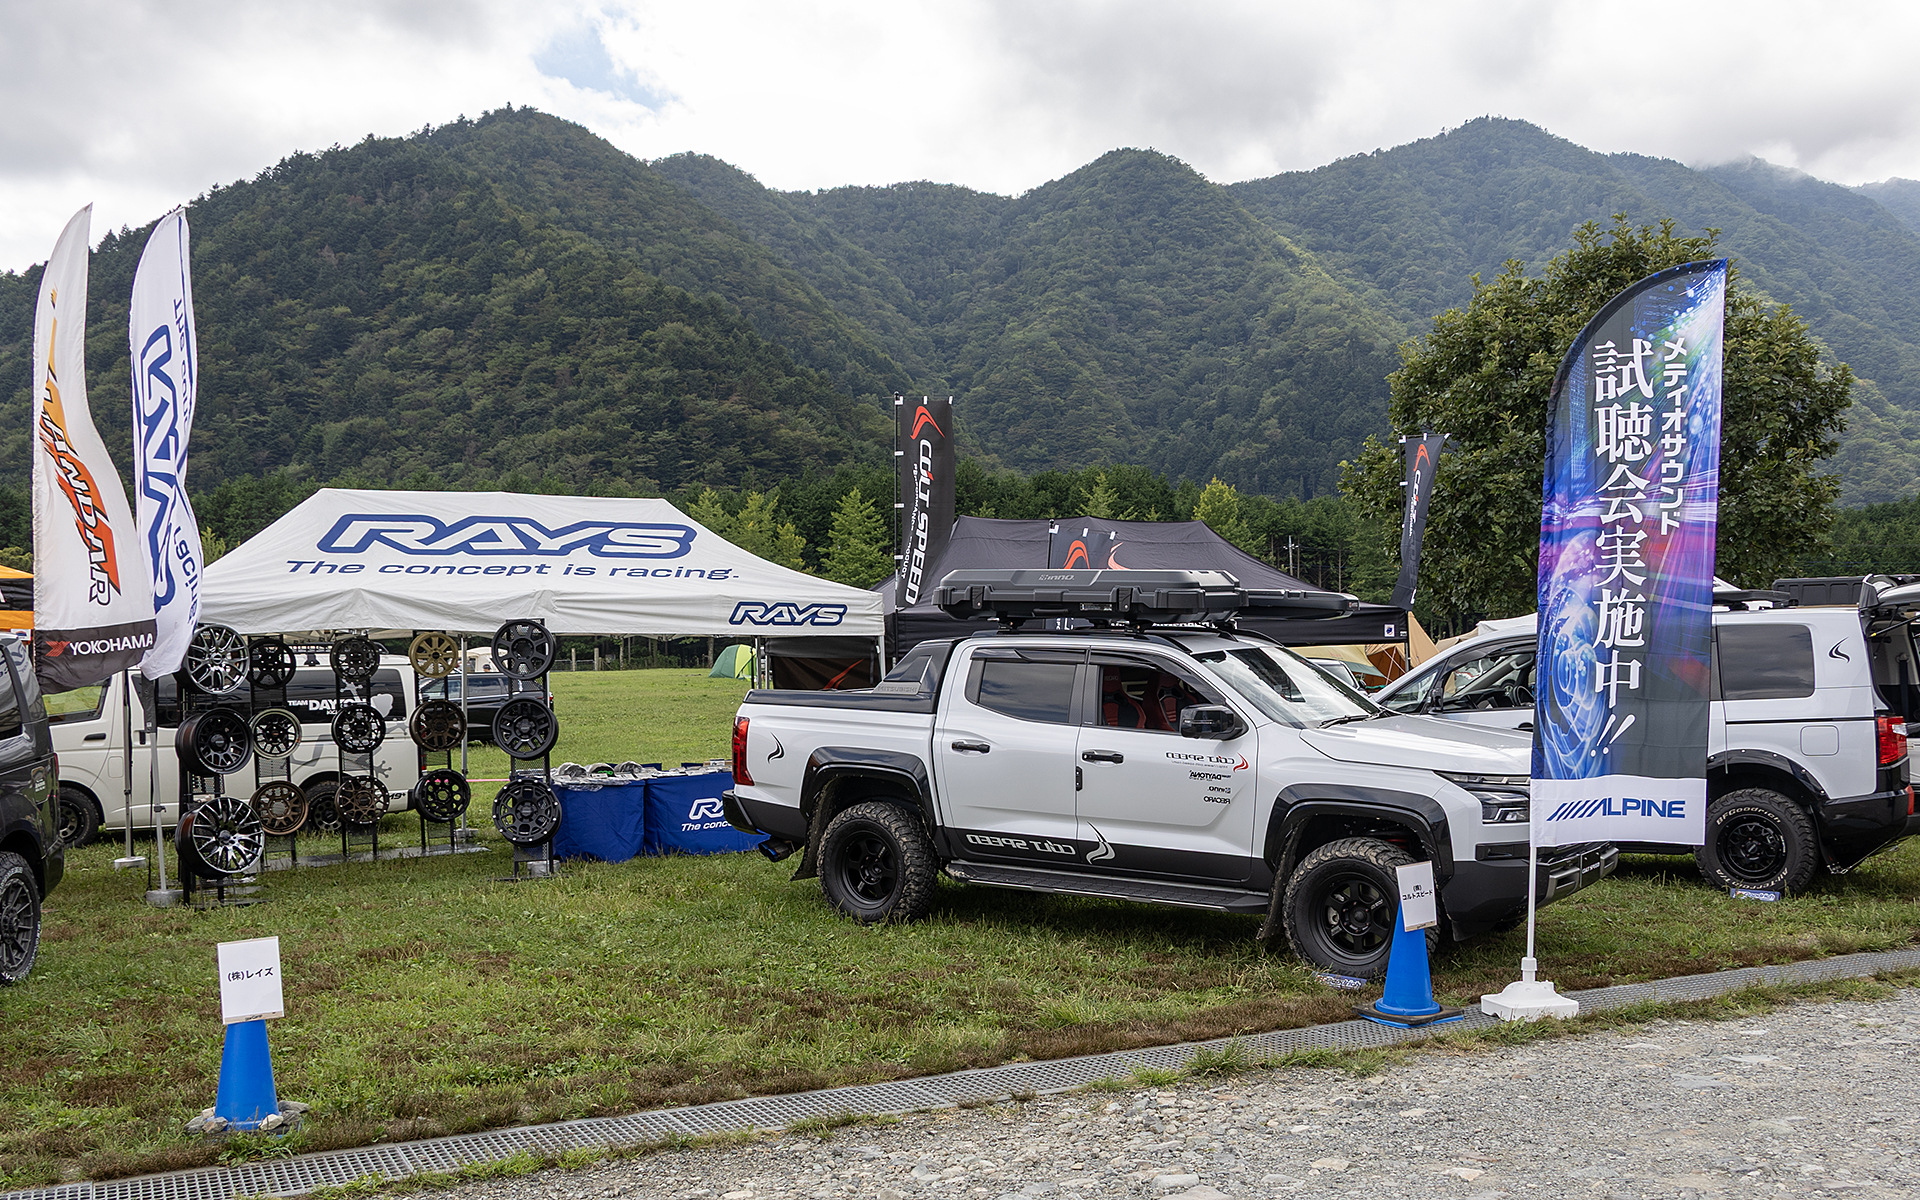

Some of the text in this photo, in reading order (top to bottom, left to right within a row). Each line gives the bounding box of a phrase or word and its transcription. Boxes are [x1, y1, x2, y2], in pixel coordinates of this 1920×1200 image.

[1660, 338, 1687, 535] メティオサウンド
[905, 439, 934, 605] COLT SPEED
[317, 513, 698, 559] RAYS
[286, 560, 740, 581] The concept is racing.
[728, 601, 848, 626] RAYS
[69, 632, 154, 657] YOKOHAMA
[1546, 797, 1686, 822] ALPINE
[1716, 806, 1781, 826] BFGoodrich
[681, 822, 702, 832] The
[227, 966, 274, 982] (株)レイズ
